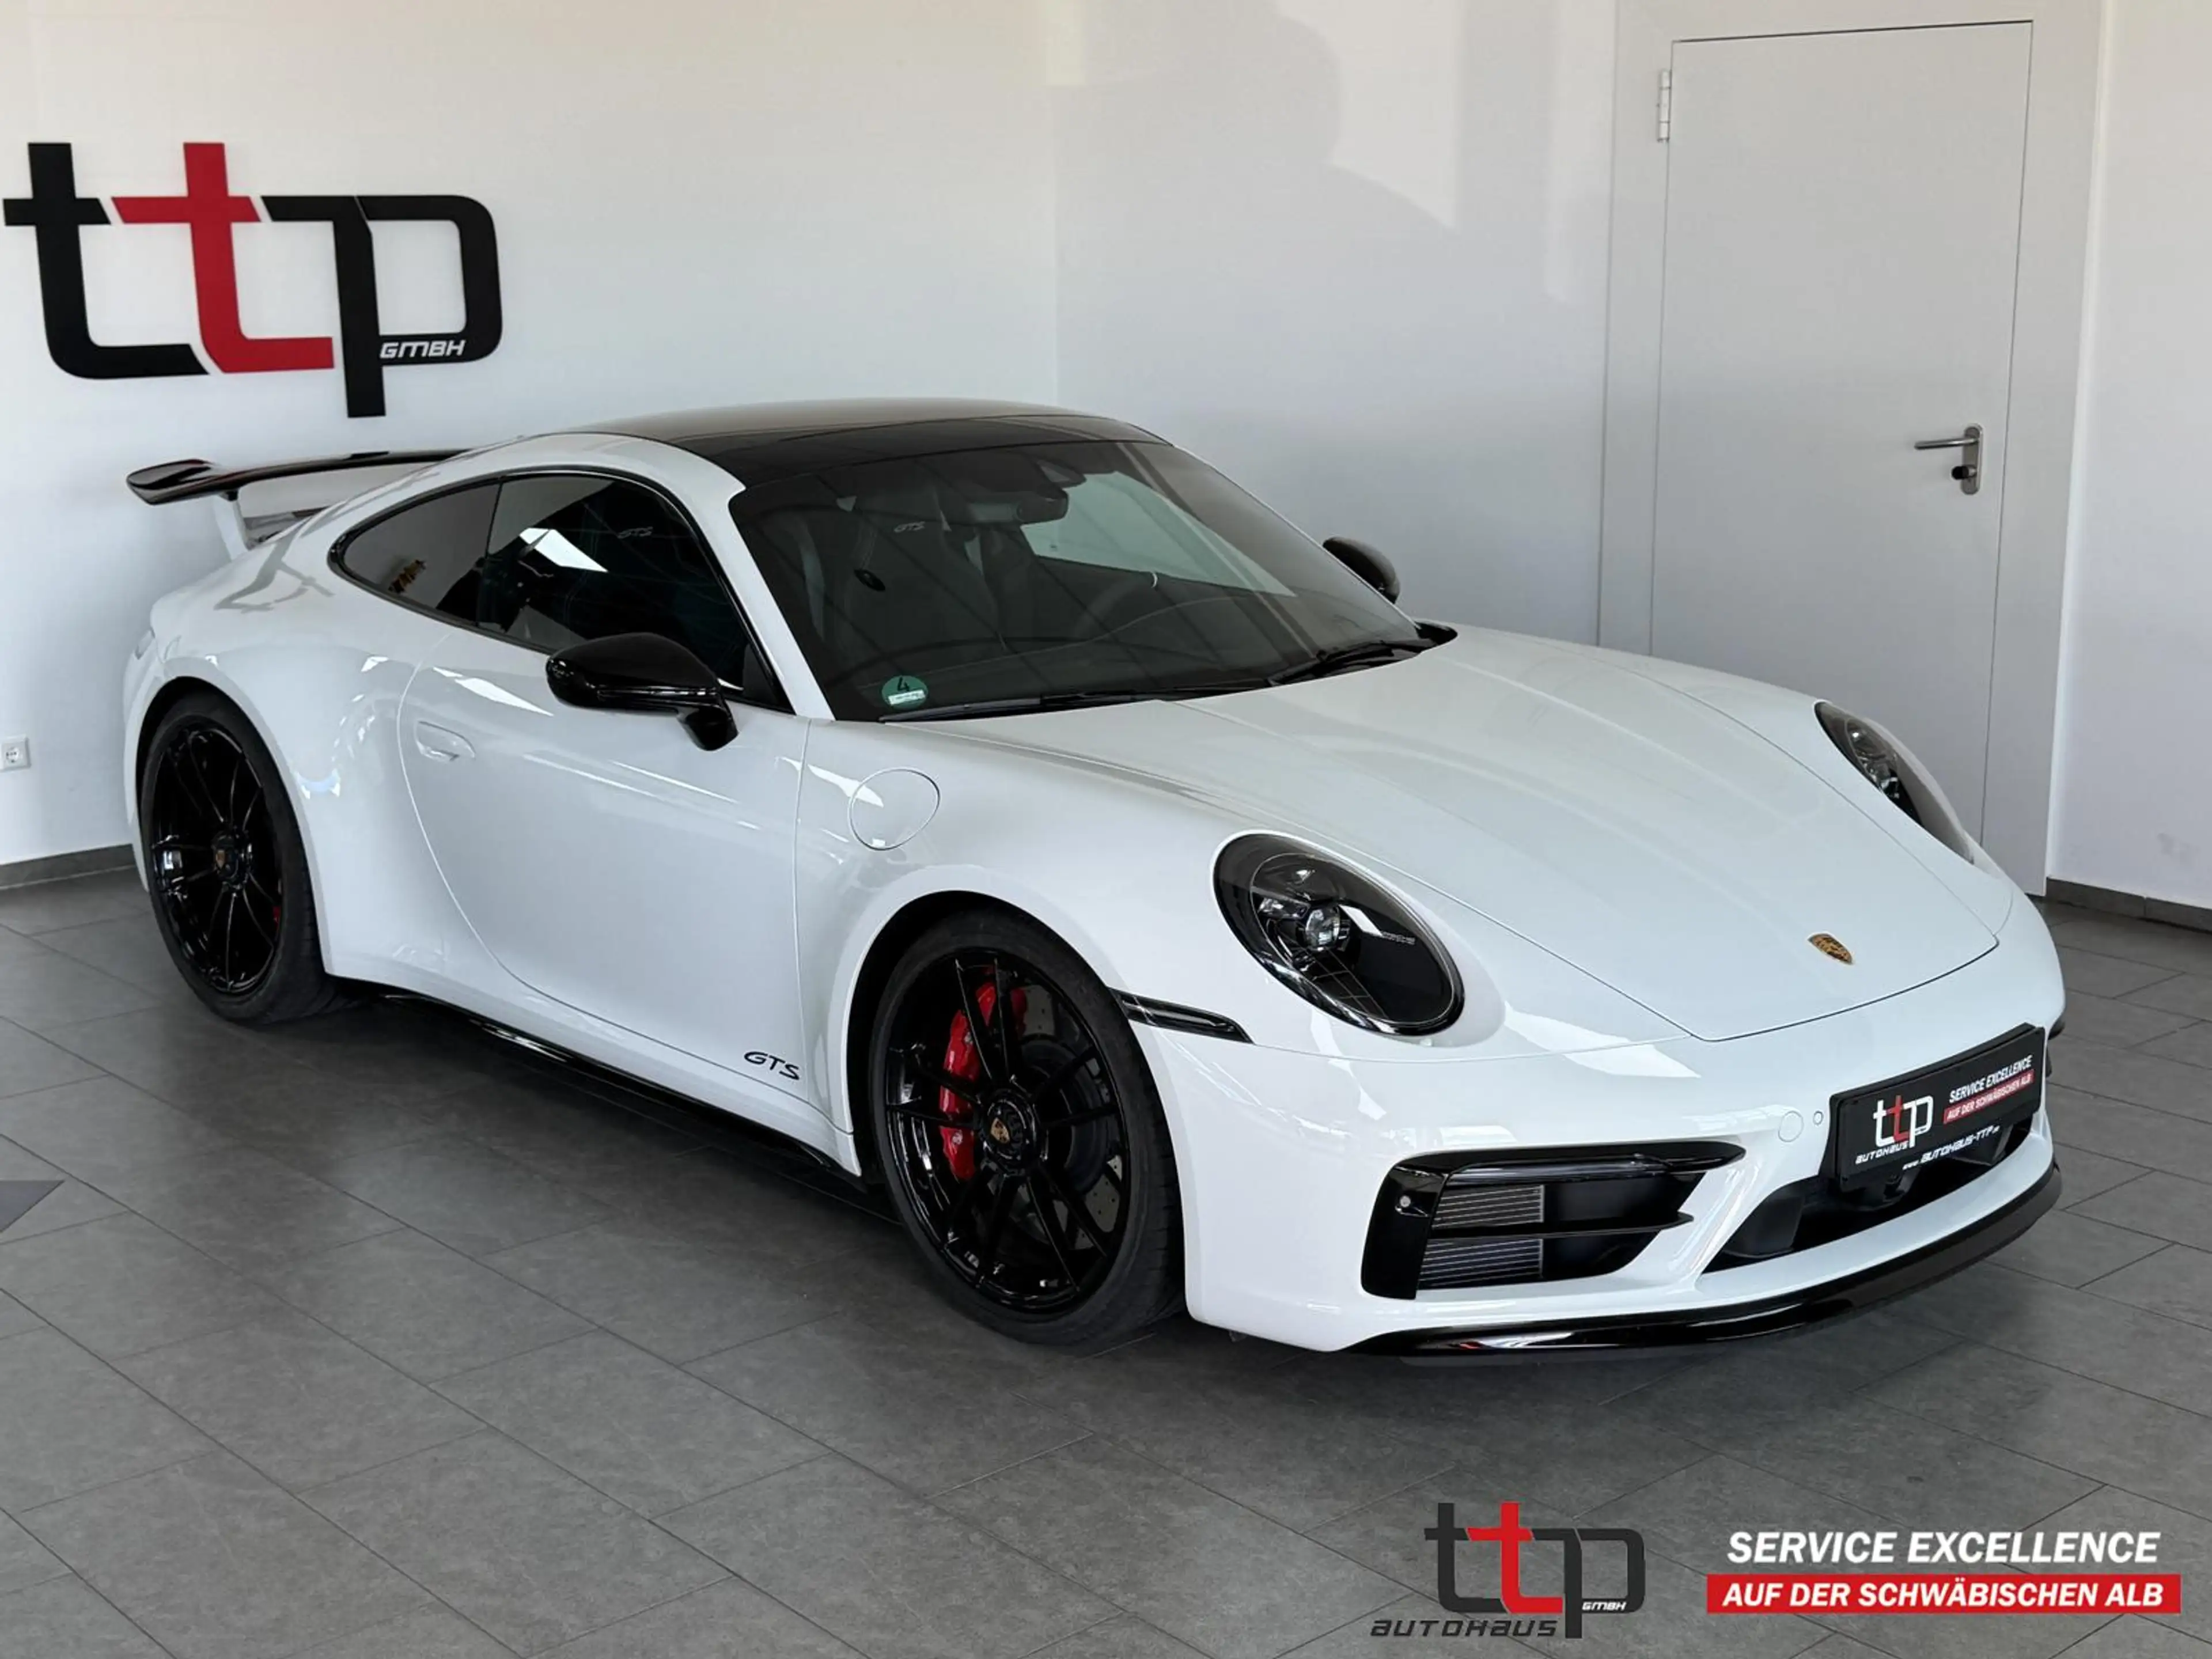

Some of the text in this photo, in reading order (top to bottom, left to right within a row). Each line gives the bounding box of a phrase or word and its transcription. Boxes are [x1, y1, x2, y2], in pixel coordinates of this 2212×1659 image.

[380, 339, 465, 359] GMBH
[897, 676, 910, 692] 4
[744, 1051, 800, 1081] GTS
[1949, 1054, 2033, 1104] SERVICE EXCELLENCE
